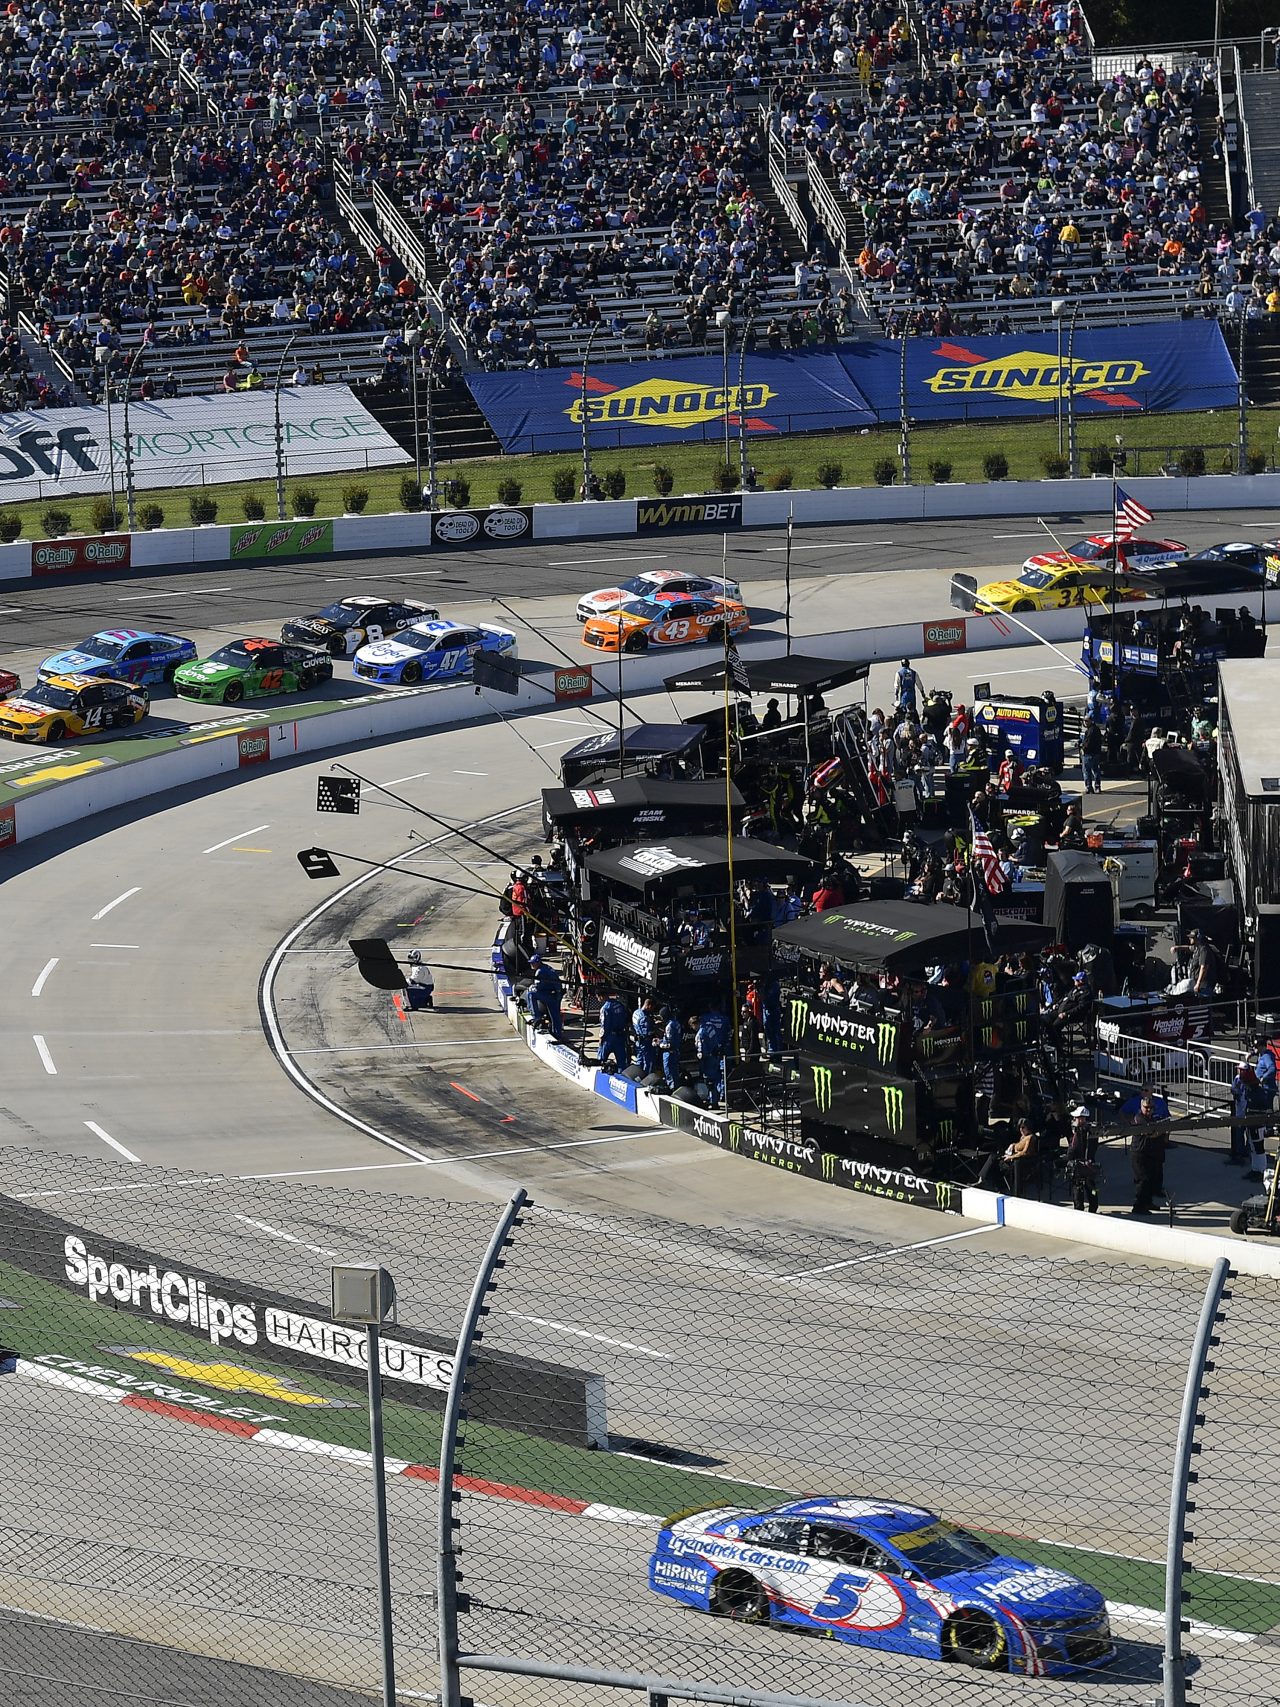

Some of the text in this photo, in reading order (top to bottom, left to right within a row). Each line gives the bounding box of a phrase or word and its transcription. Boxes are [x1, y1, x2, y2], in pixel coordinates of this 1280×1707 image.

[938, 361, 1141, 391] SUNOCO
[575, 385, 770, 421] SUNOCO
[112, 413, 380, 459] MORTGAGE
[638, 502, 741, 527] wynnBET
[36, 547, 77, 566] O'Reilly
[85, 542, 127, 560] O'Reilly
[1144, 552, 1183, 563] Quick Lane
[1058, 587, 1085, 607] 34
[366, 624, 384, 644] 8
[665, 620, 690, 640] 43
[926, 628, 963, 642] O'Reilly
[368, 642, 408, 660] Kroger
[439, 650, 461, 671] 47
[127, 661, 149, 682] 17
[178, 669, 209, 681] clover
[260, 668, 285, 690] 42
[558, 672, 588, 692] O'Reilly
[82, 706, 103, 729] 14
[996, 709, 1012, 717] AUTO
[1012, 709, 1032, 719] PARTS
[276, 726, 287, 742] 1
[239, 737, 268, 756] O'Reilly
[1028, 750, 1037, 759] 9
[632, 815, 666, 823] PENSKE
[1003, 807, 1036, 816] MENARDS
[843, 918, 899, 936] MONSTER
[843, 925, 881, 938] ENERGY
[661, 946, 670, 956] 5
[684, 953, 723, 969] Hendrick
[691, 962, 721, 972] cars.com
[809, 1010, 877, 1045] MONSTER
[1153, 1017, 1186, 1032] Hendrick
[1193, 1025, 1205, 1039] 5
[817, 1033, 865, 1053] ENERGY
[934, 1036, 962, 1046] MONSTER
[693, 1117, 723, 1144] xfinity
[753, 1150, 803, 1172] ENERGY
[854, 1180, 915, 1202] ENERGY
[63, 1234, 259, 1346] SportClips
[33, 1353, 290, 1424] CHEVROLET
[654, 1560, 708, 1584] HIRING
[810, 1571, 873, 1622] 5
[1042, 1633, 1055, 1646] 5
